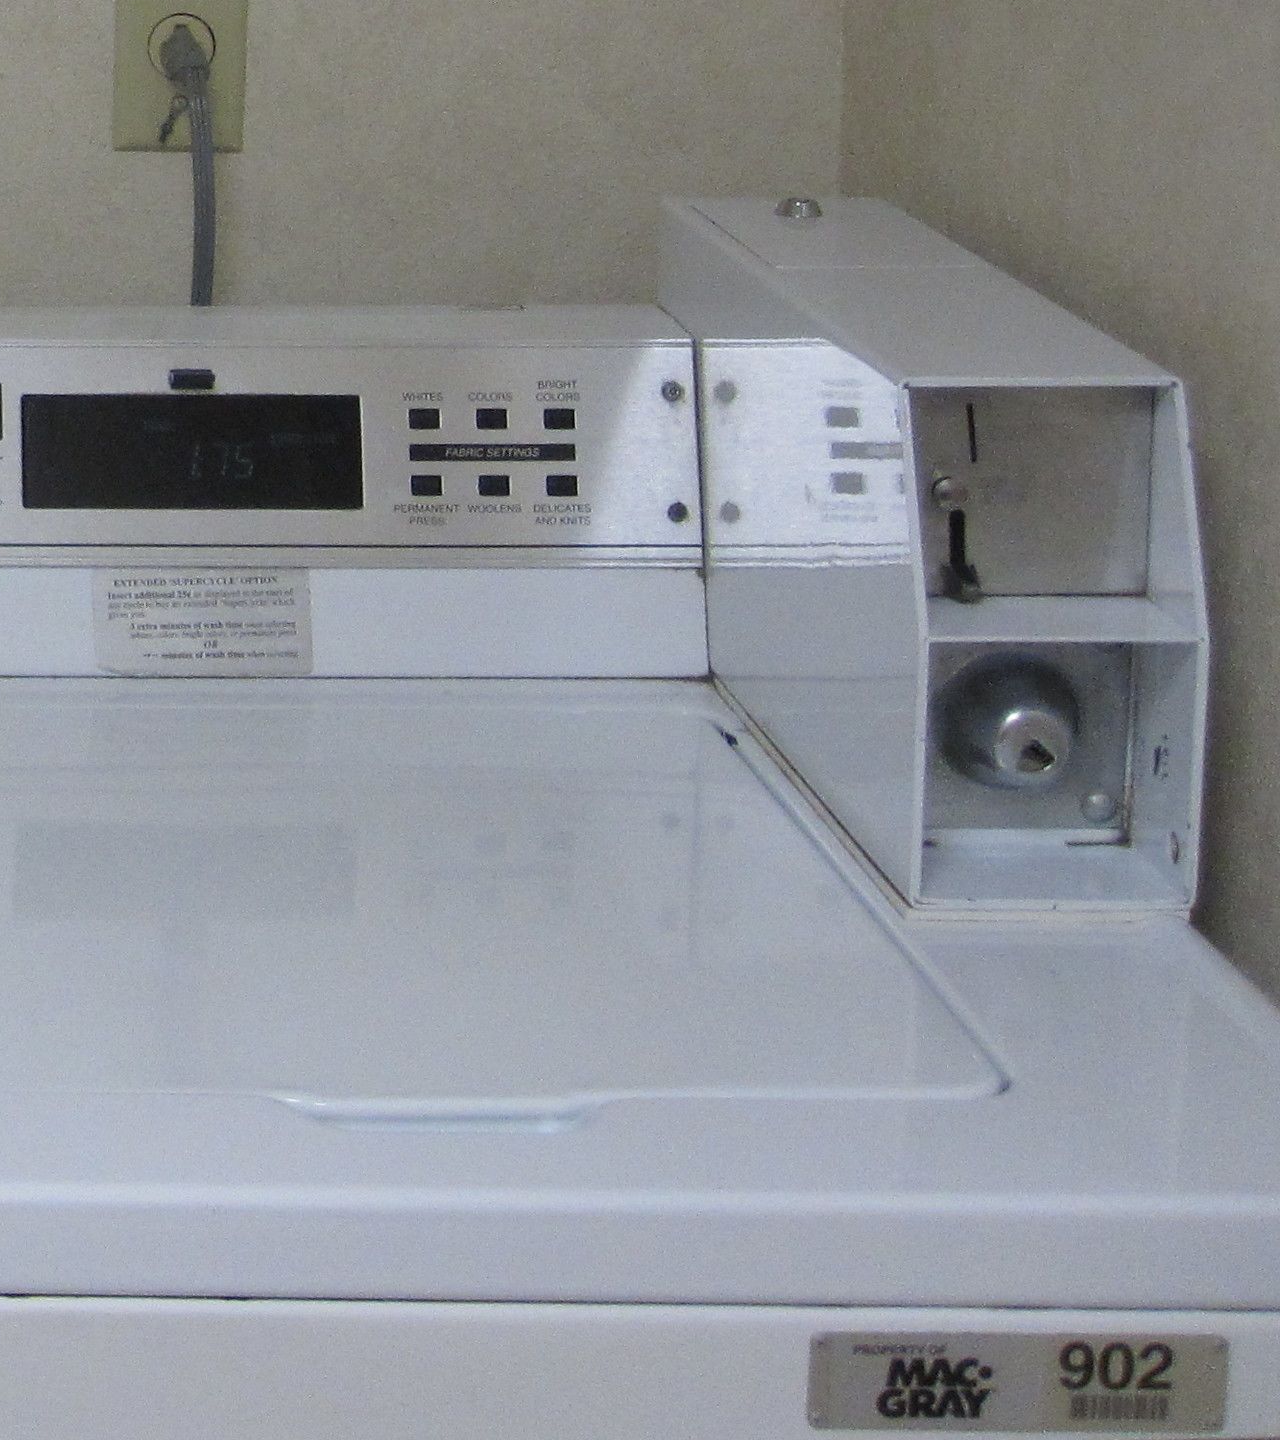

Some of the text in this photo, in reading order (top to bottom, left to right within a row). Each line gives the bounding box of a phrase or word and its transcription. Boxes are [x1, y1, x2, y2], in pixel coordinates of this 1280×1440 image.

[537, 380, 578, 390] BRIGHT
[402, 392, 444, 402] WHITES
[468, 392, 514, 402] COLORS
[535, 392, 581, 402] COLORS
[445, 447, 540, 458] FABRIC SETTINGS
[393, 503, 461, 513] PERMANENT
[533, 503, 592, 513] DELICATES
[535, 516, 592, 526] AND KNITS
[1058, 1340, 1175, 1392] 902
[875, 1387, 992, 1419] GRAY
